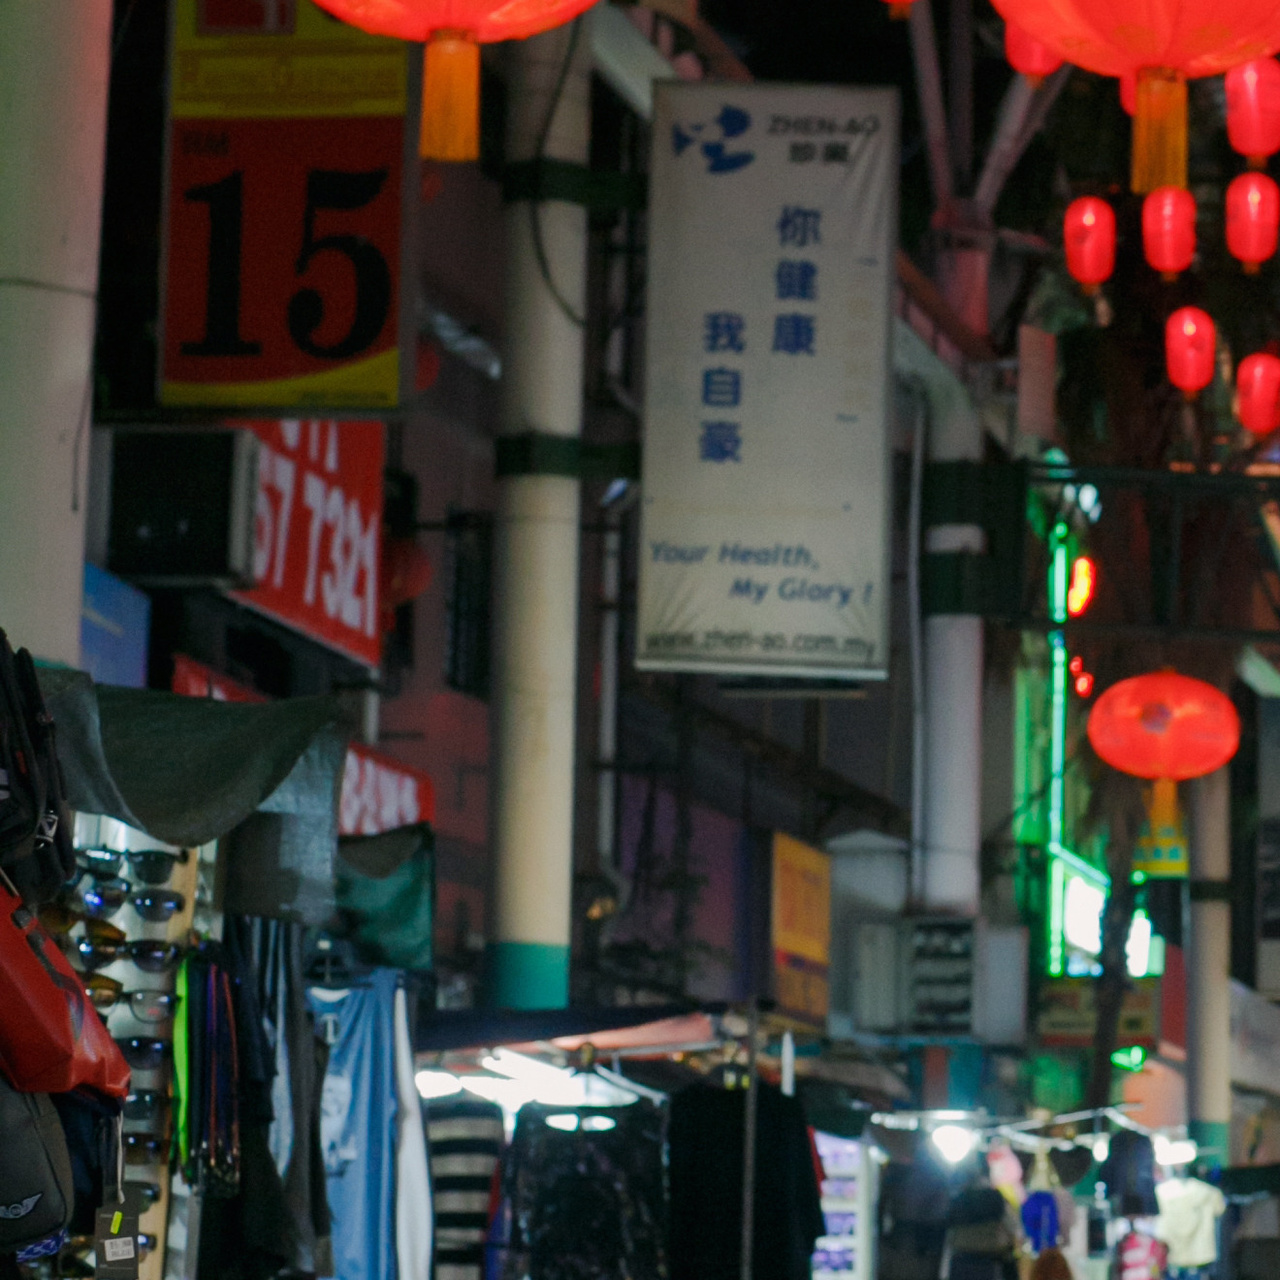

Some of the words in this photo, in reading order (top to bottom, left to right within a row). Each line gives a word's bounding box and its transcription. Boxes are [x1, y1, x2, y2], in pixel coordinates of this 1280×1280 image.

[181, 168, 392, 361] 15
[651, 542, 710, 567] Your
[730, 578, 770, 605] My
[777, 576, 854, 609] Glory
